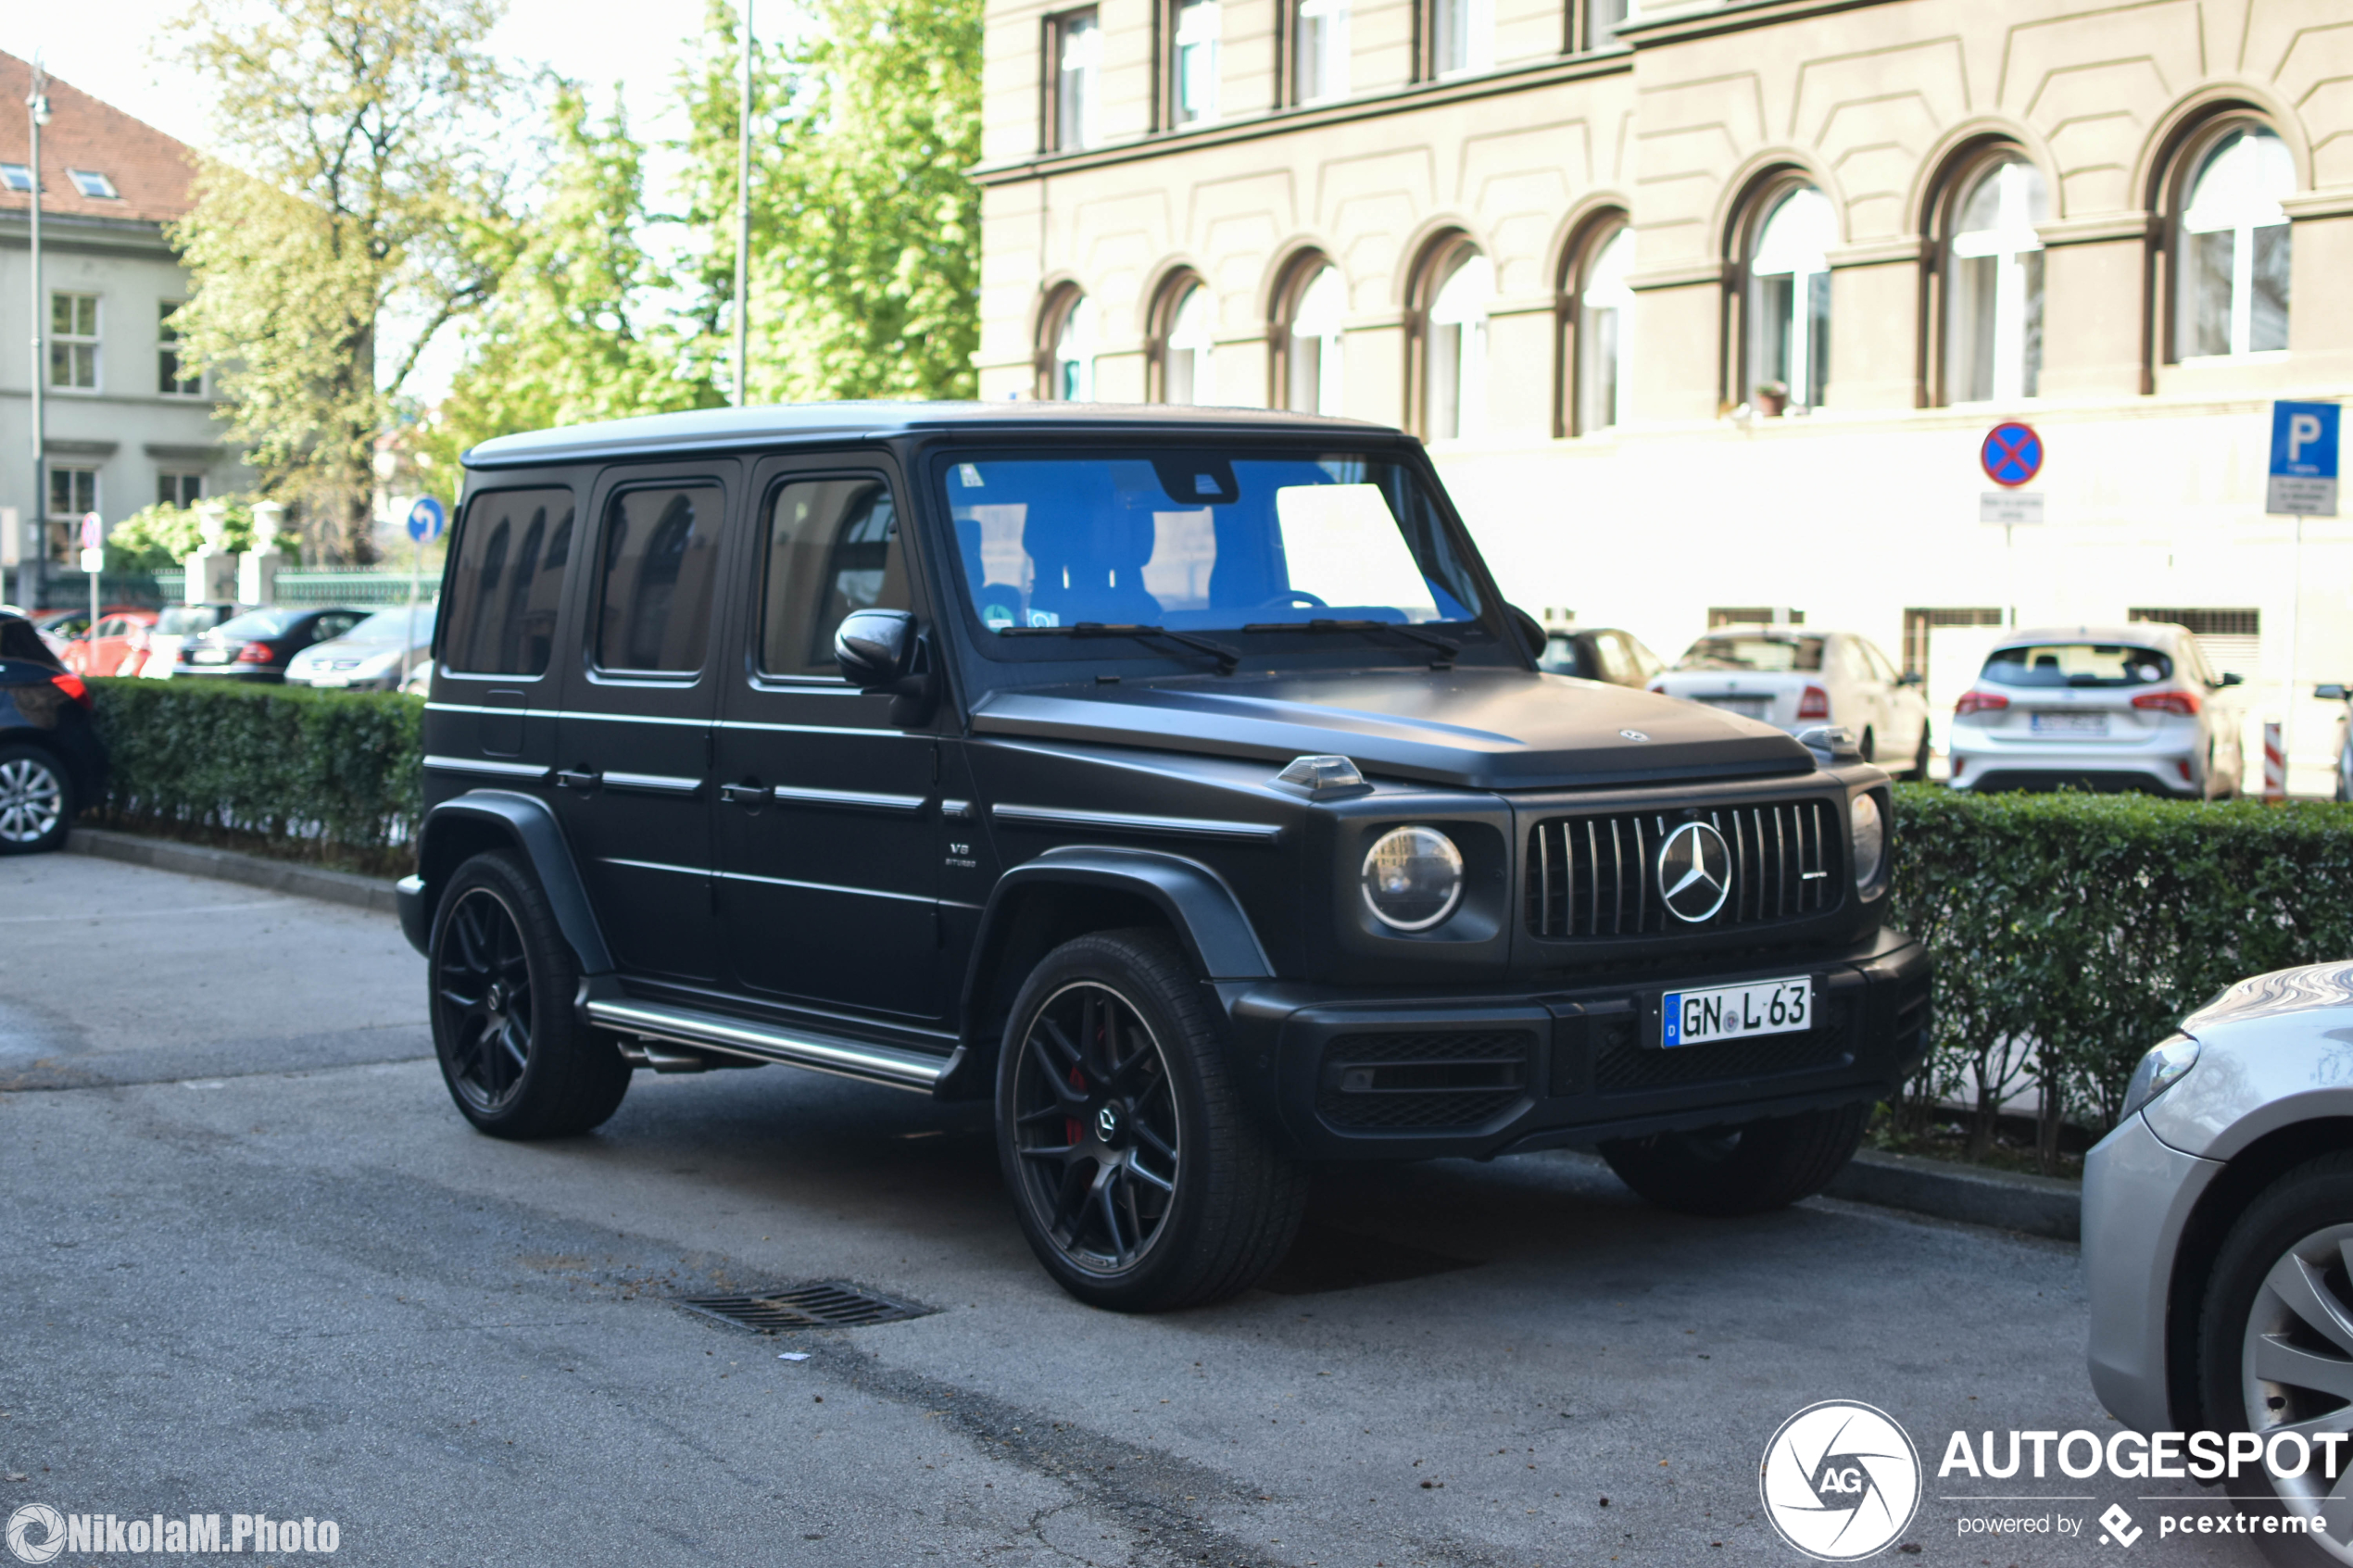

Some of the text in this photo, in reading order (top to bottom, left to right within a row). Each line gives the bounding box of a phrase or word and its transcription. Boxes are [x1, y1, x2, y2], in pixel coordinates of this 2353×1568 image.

[2289, 414, 2322, 461] P
[950, 844, 969, 854] V8
[1683, 986, 1805, 1037] GN L 63
[1667, 1024, 1676, 1037] D
